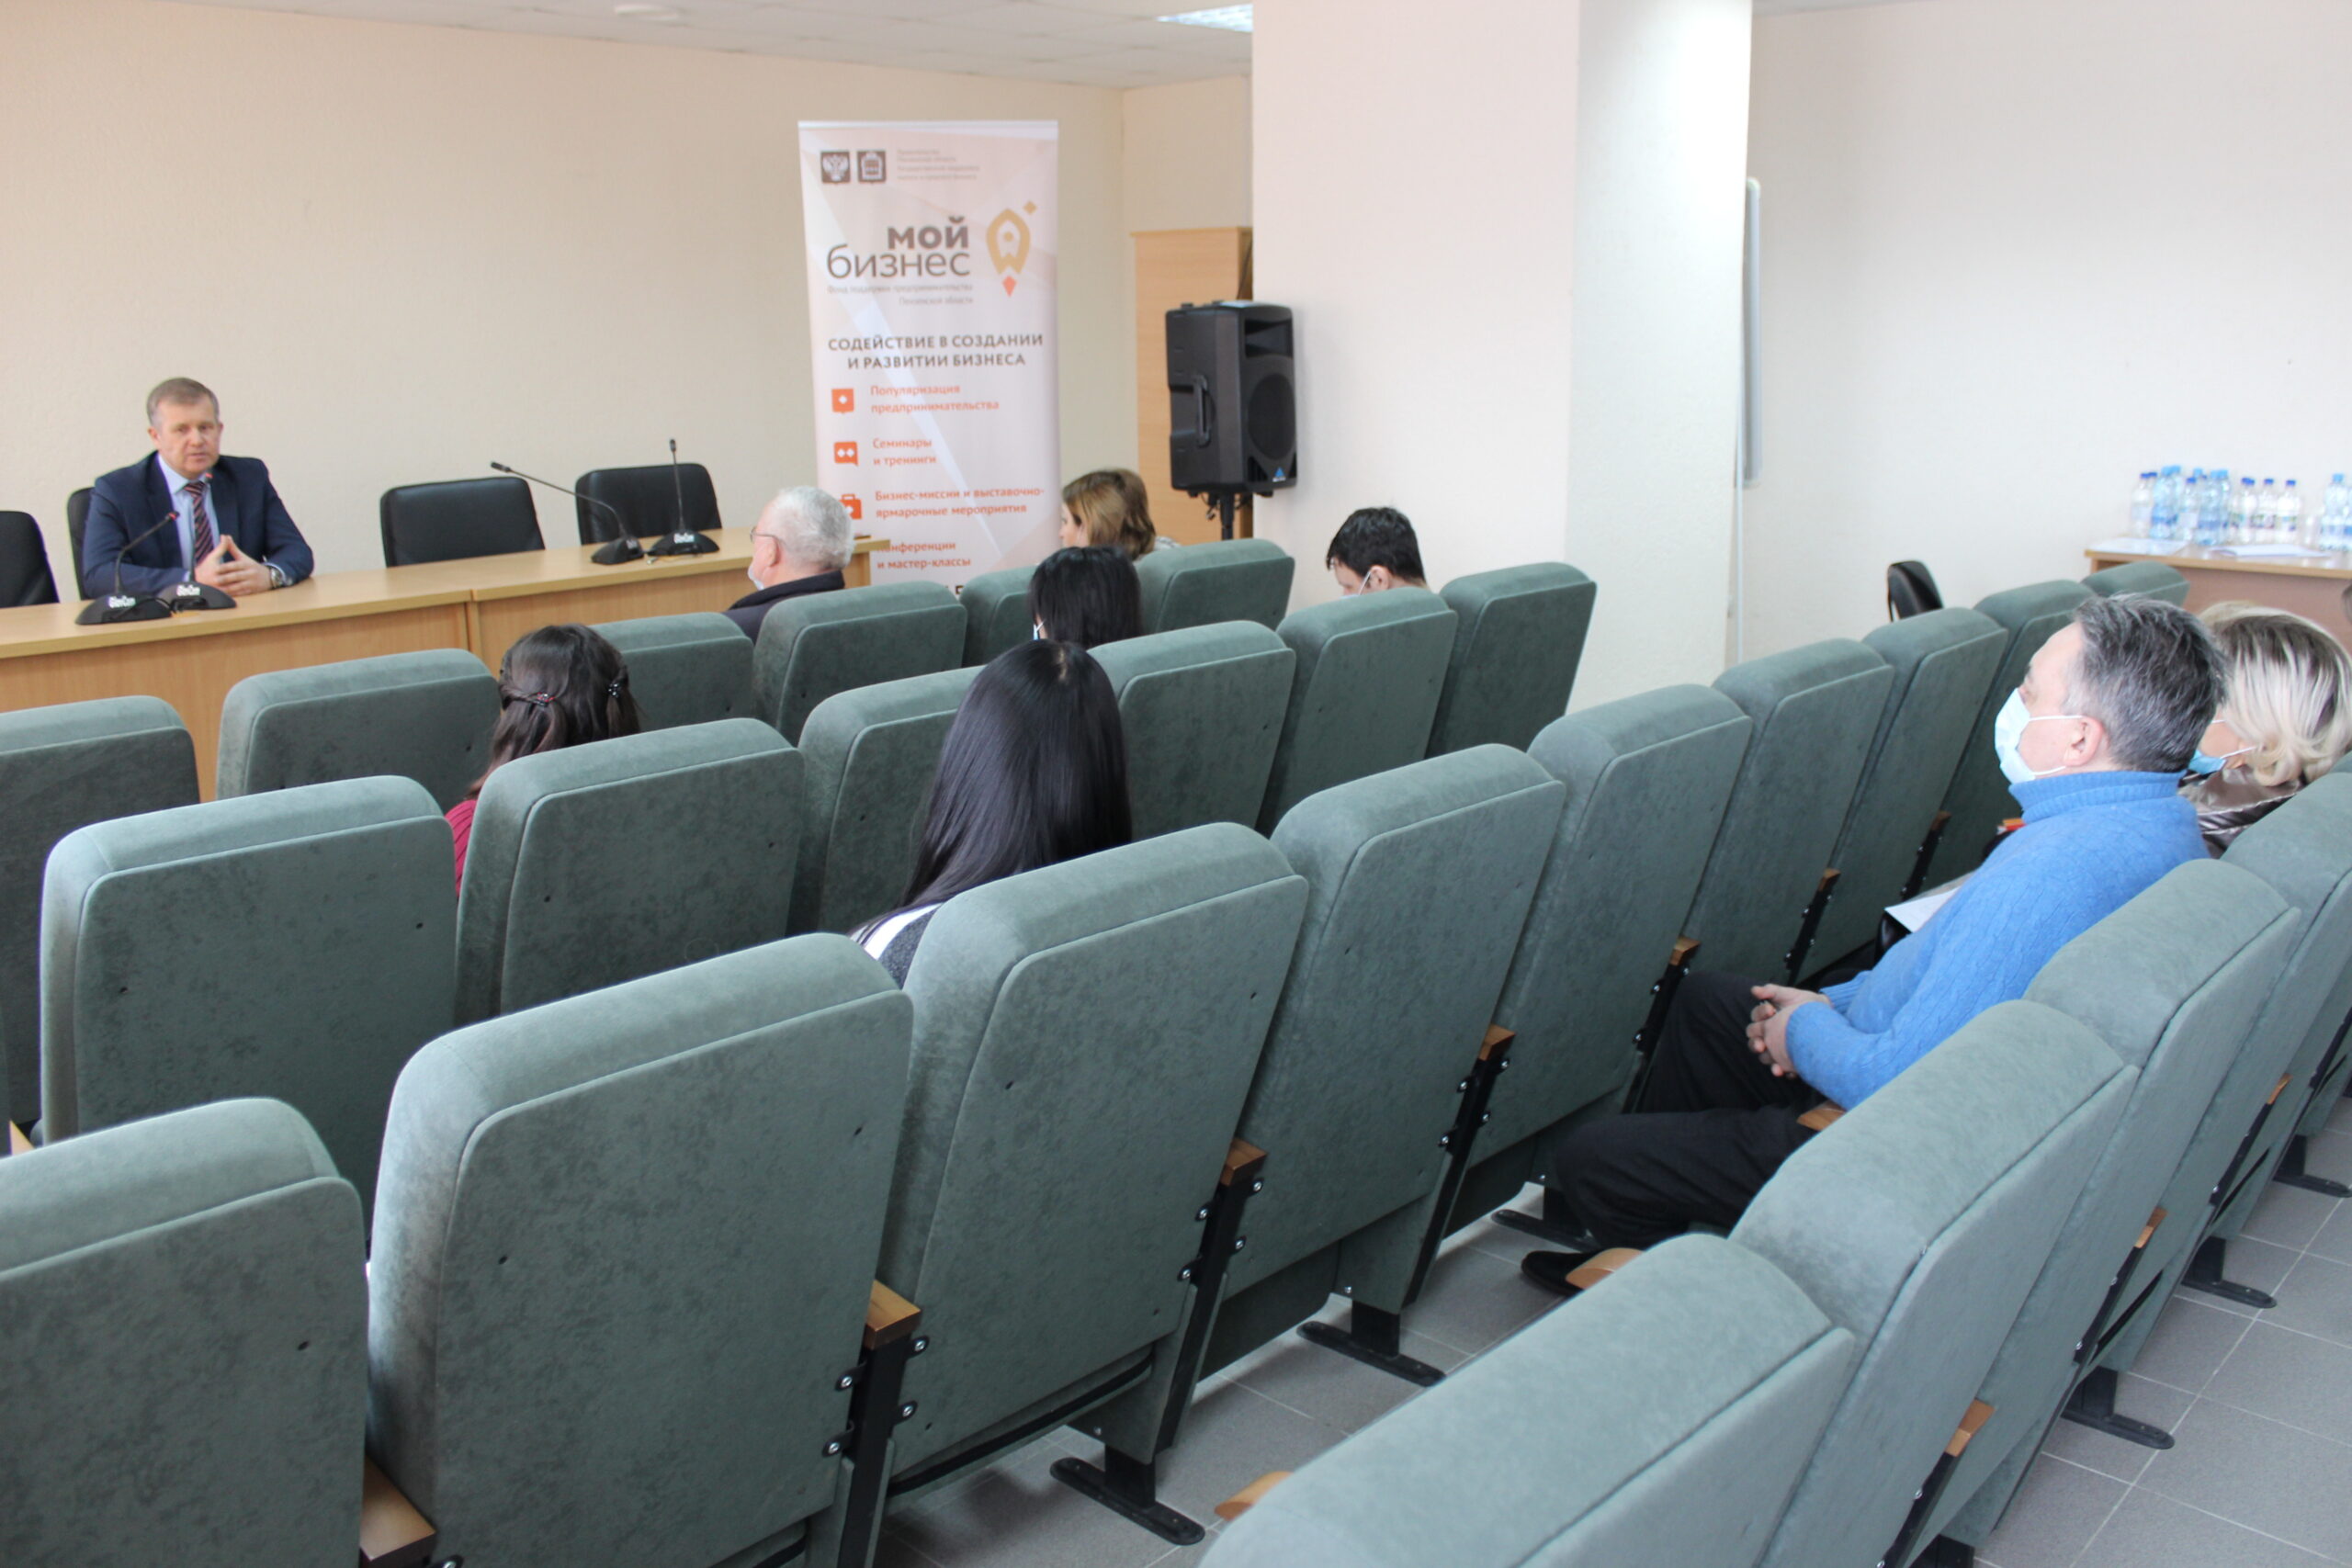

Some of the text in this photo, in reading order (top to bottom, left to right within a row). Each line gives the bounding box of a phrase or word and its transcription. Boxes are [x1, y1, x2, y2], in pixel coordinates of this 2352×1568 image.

[888, 216, 968, 249] мой
[827, 243, 970, 278] бизнес
[829, 334, 1043, 351] СОДЕЙСТВИЕ В СОЗДАНИИ
[848, 353, 1025, 369] И РАЗВИТИИ БИЗНЕСА
[871, 385, 960, 399] Популяризация
[871, 400, 1000, 414] предпринимательства
[873, 438, 932, 450] Семинары
[885, 456, 936, 467] тренинги
[875, 490, 960, 501] Бизнес-миссии
[974, 487, 1044, 499] выставочно-
[876, 504, 1027, 519] ярмарочные мероприятия
[888, 558, 971, 570] мастер-классы
